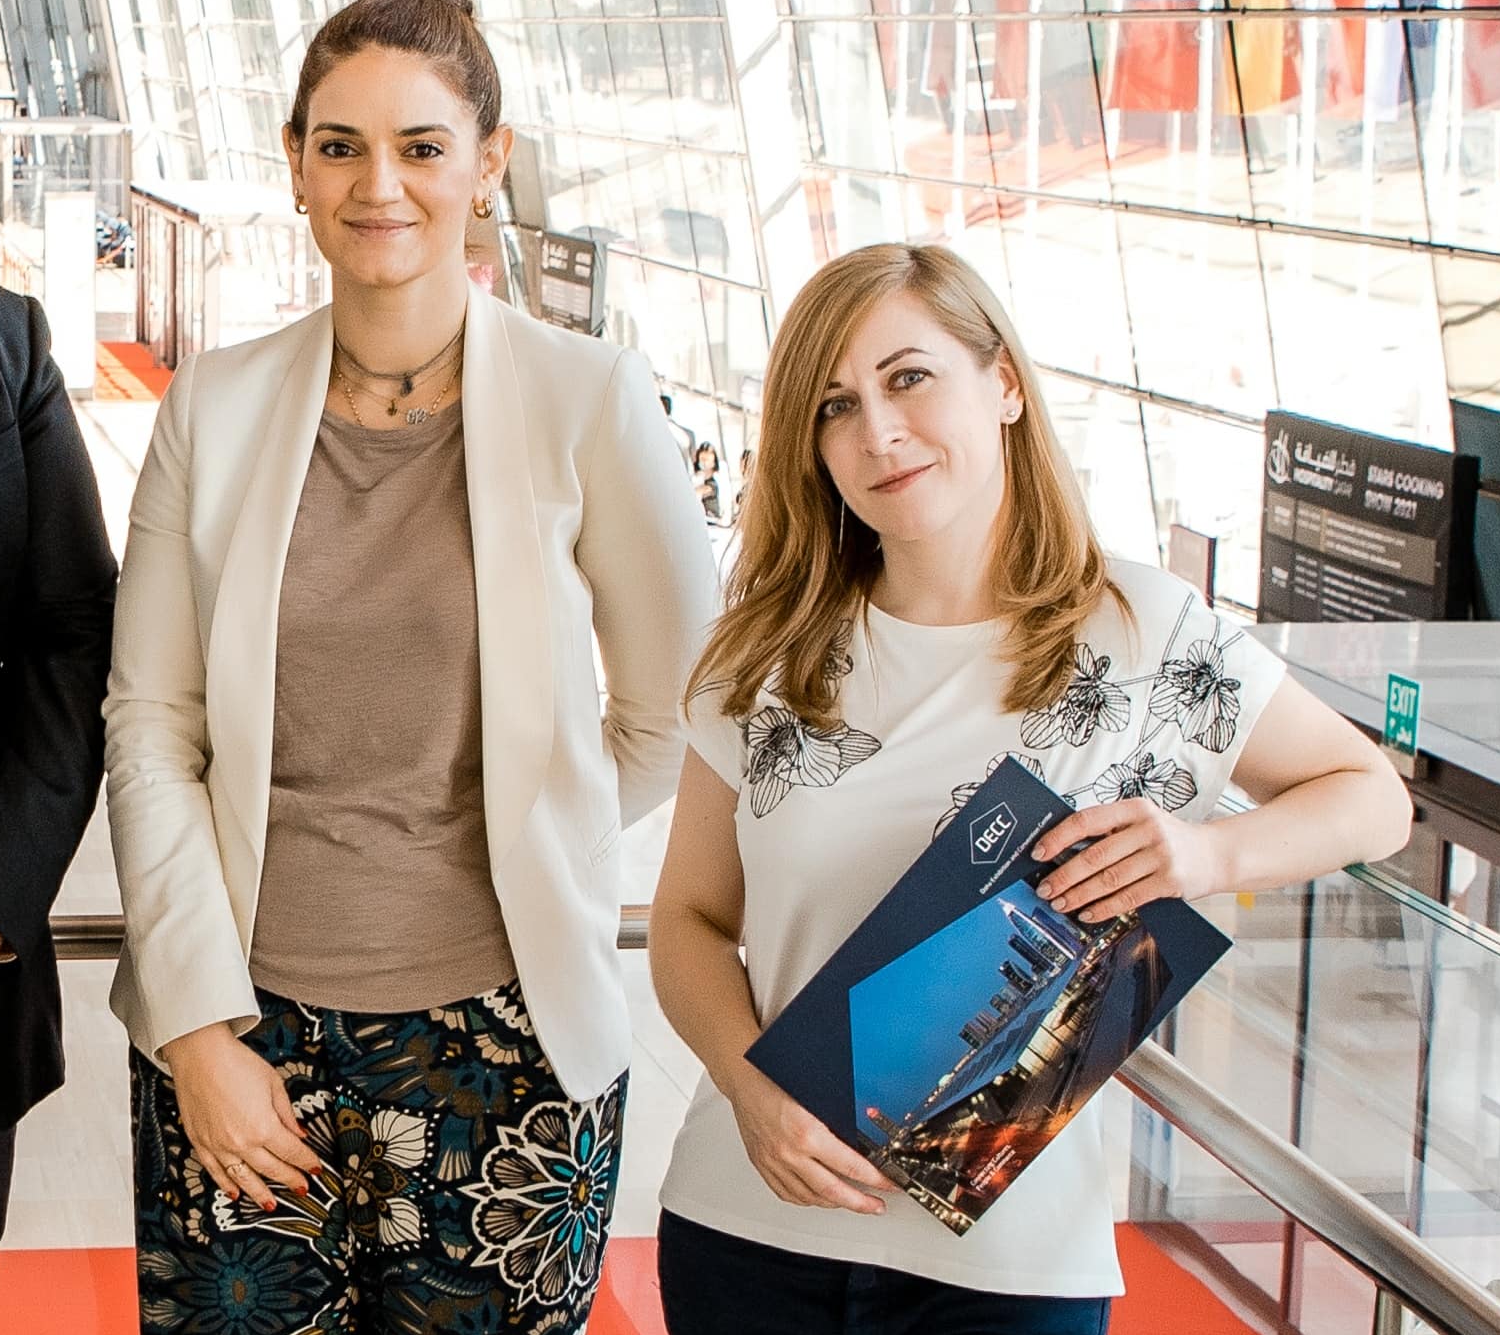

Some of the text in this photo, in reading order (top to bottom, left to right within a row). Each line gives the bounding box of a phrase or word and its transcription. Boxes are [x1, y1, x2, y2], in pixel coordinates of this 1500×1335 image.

[1395, 473, 1444, 500] COOKING
[1390, 681, 1416, 718] EXIT
[975, 814, 1012, 853] DECC
